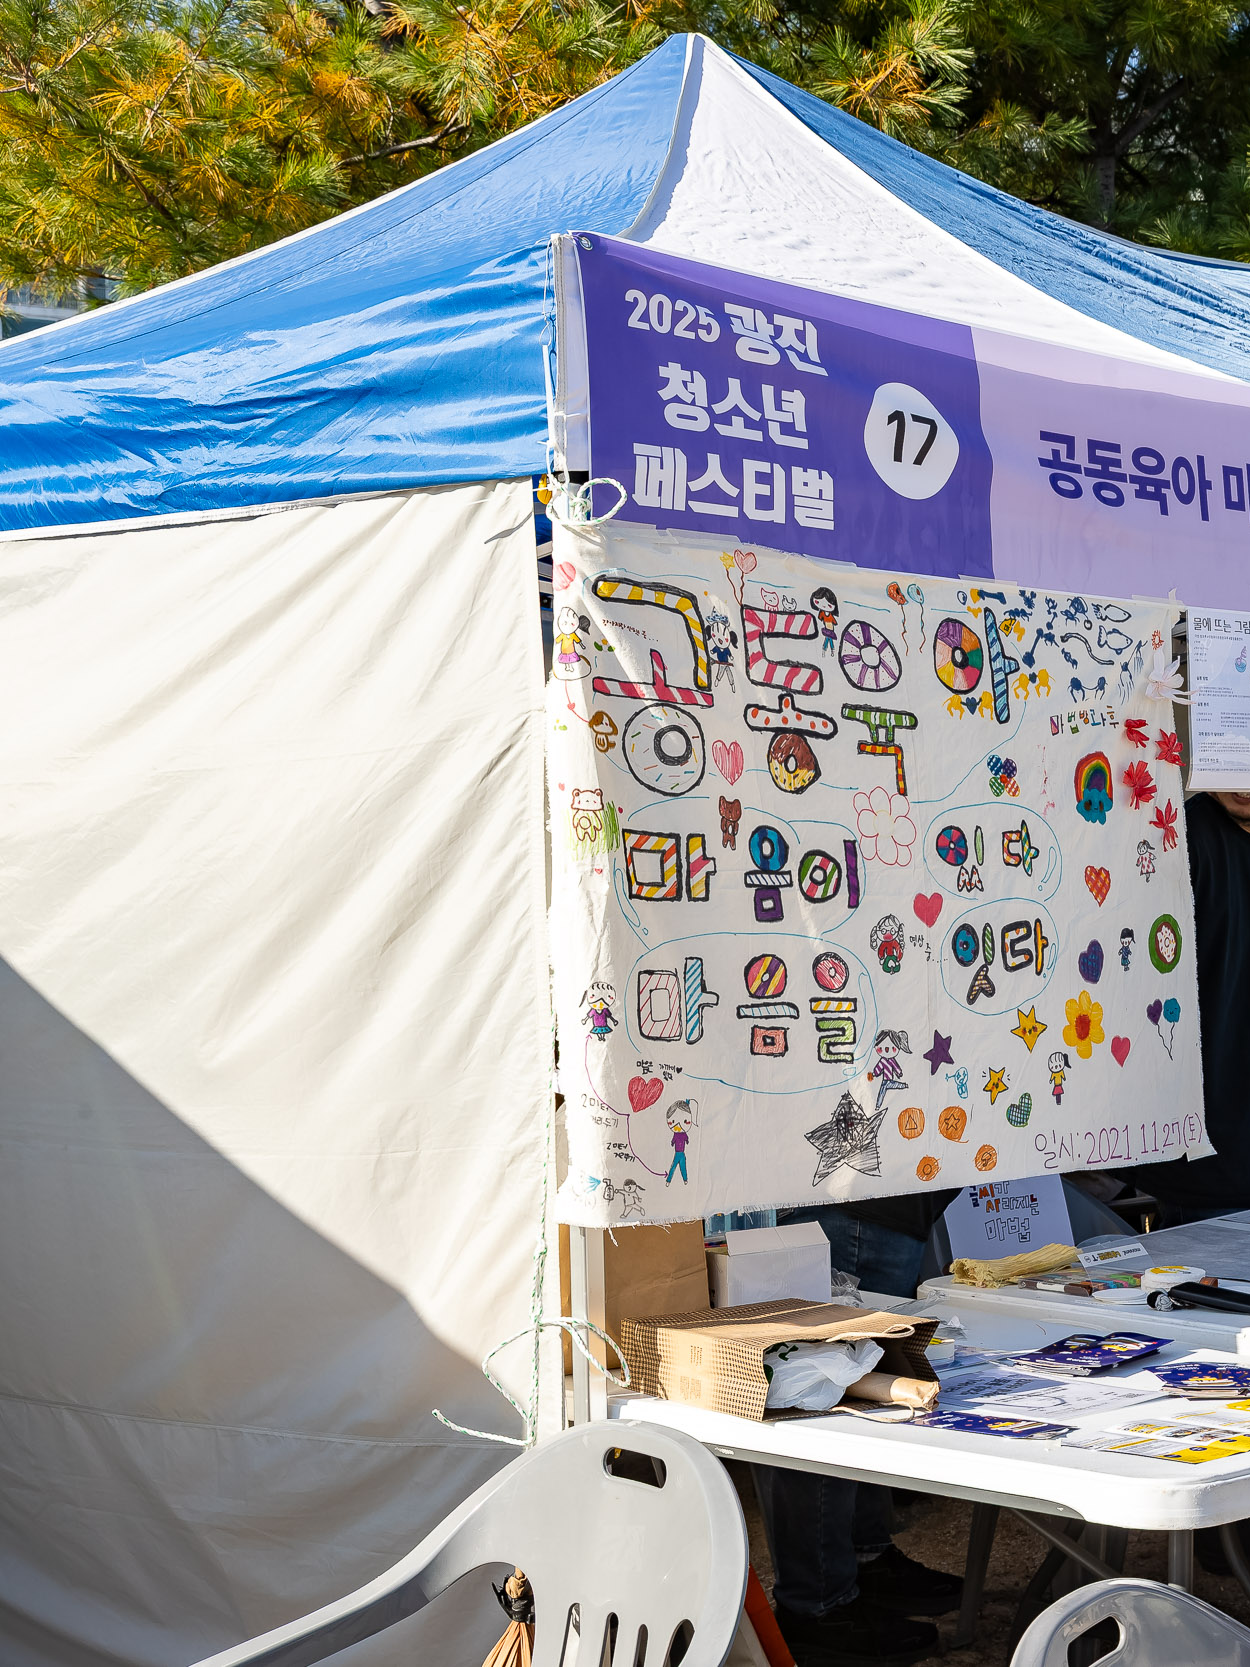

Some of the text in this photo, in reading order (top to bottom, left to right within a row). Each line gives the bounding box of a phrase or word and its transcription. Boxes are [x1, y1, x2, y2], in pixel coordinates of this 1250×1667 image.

[624, 288, 829, 377] 2025 광진
[657, 360, 809, 450] 청소년
[886, 409, 939, 467] 17
[631, 442, 835, 531] 페스티벌
[1037, 430, 1213, 522] 공동육아
[1193, 617, 1212, 632] 물에
[1214, 618, 1232, 633] 뜨는
[591, 573, 1021, 798] 공동육아
[1049, 704, 1120, 737] 마법방과후
[621, 823, 859, 923] 마음이
[636, 951, 859, 1065] 마음을
[984, 1216, 1031, 1243] 마법
